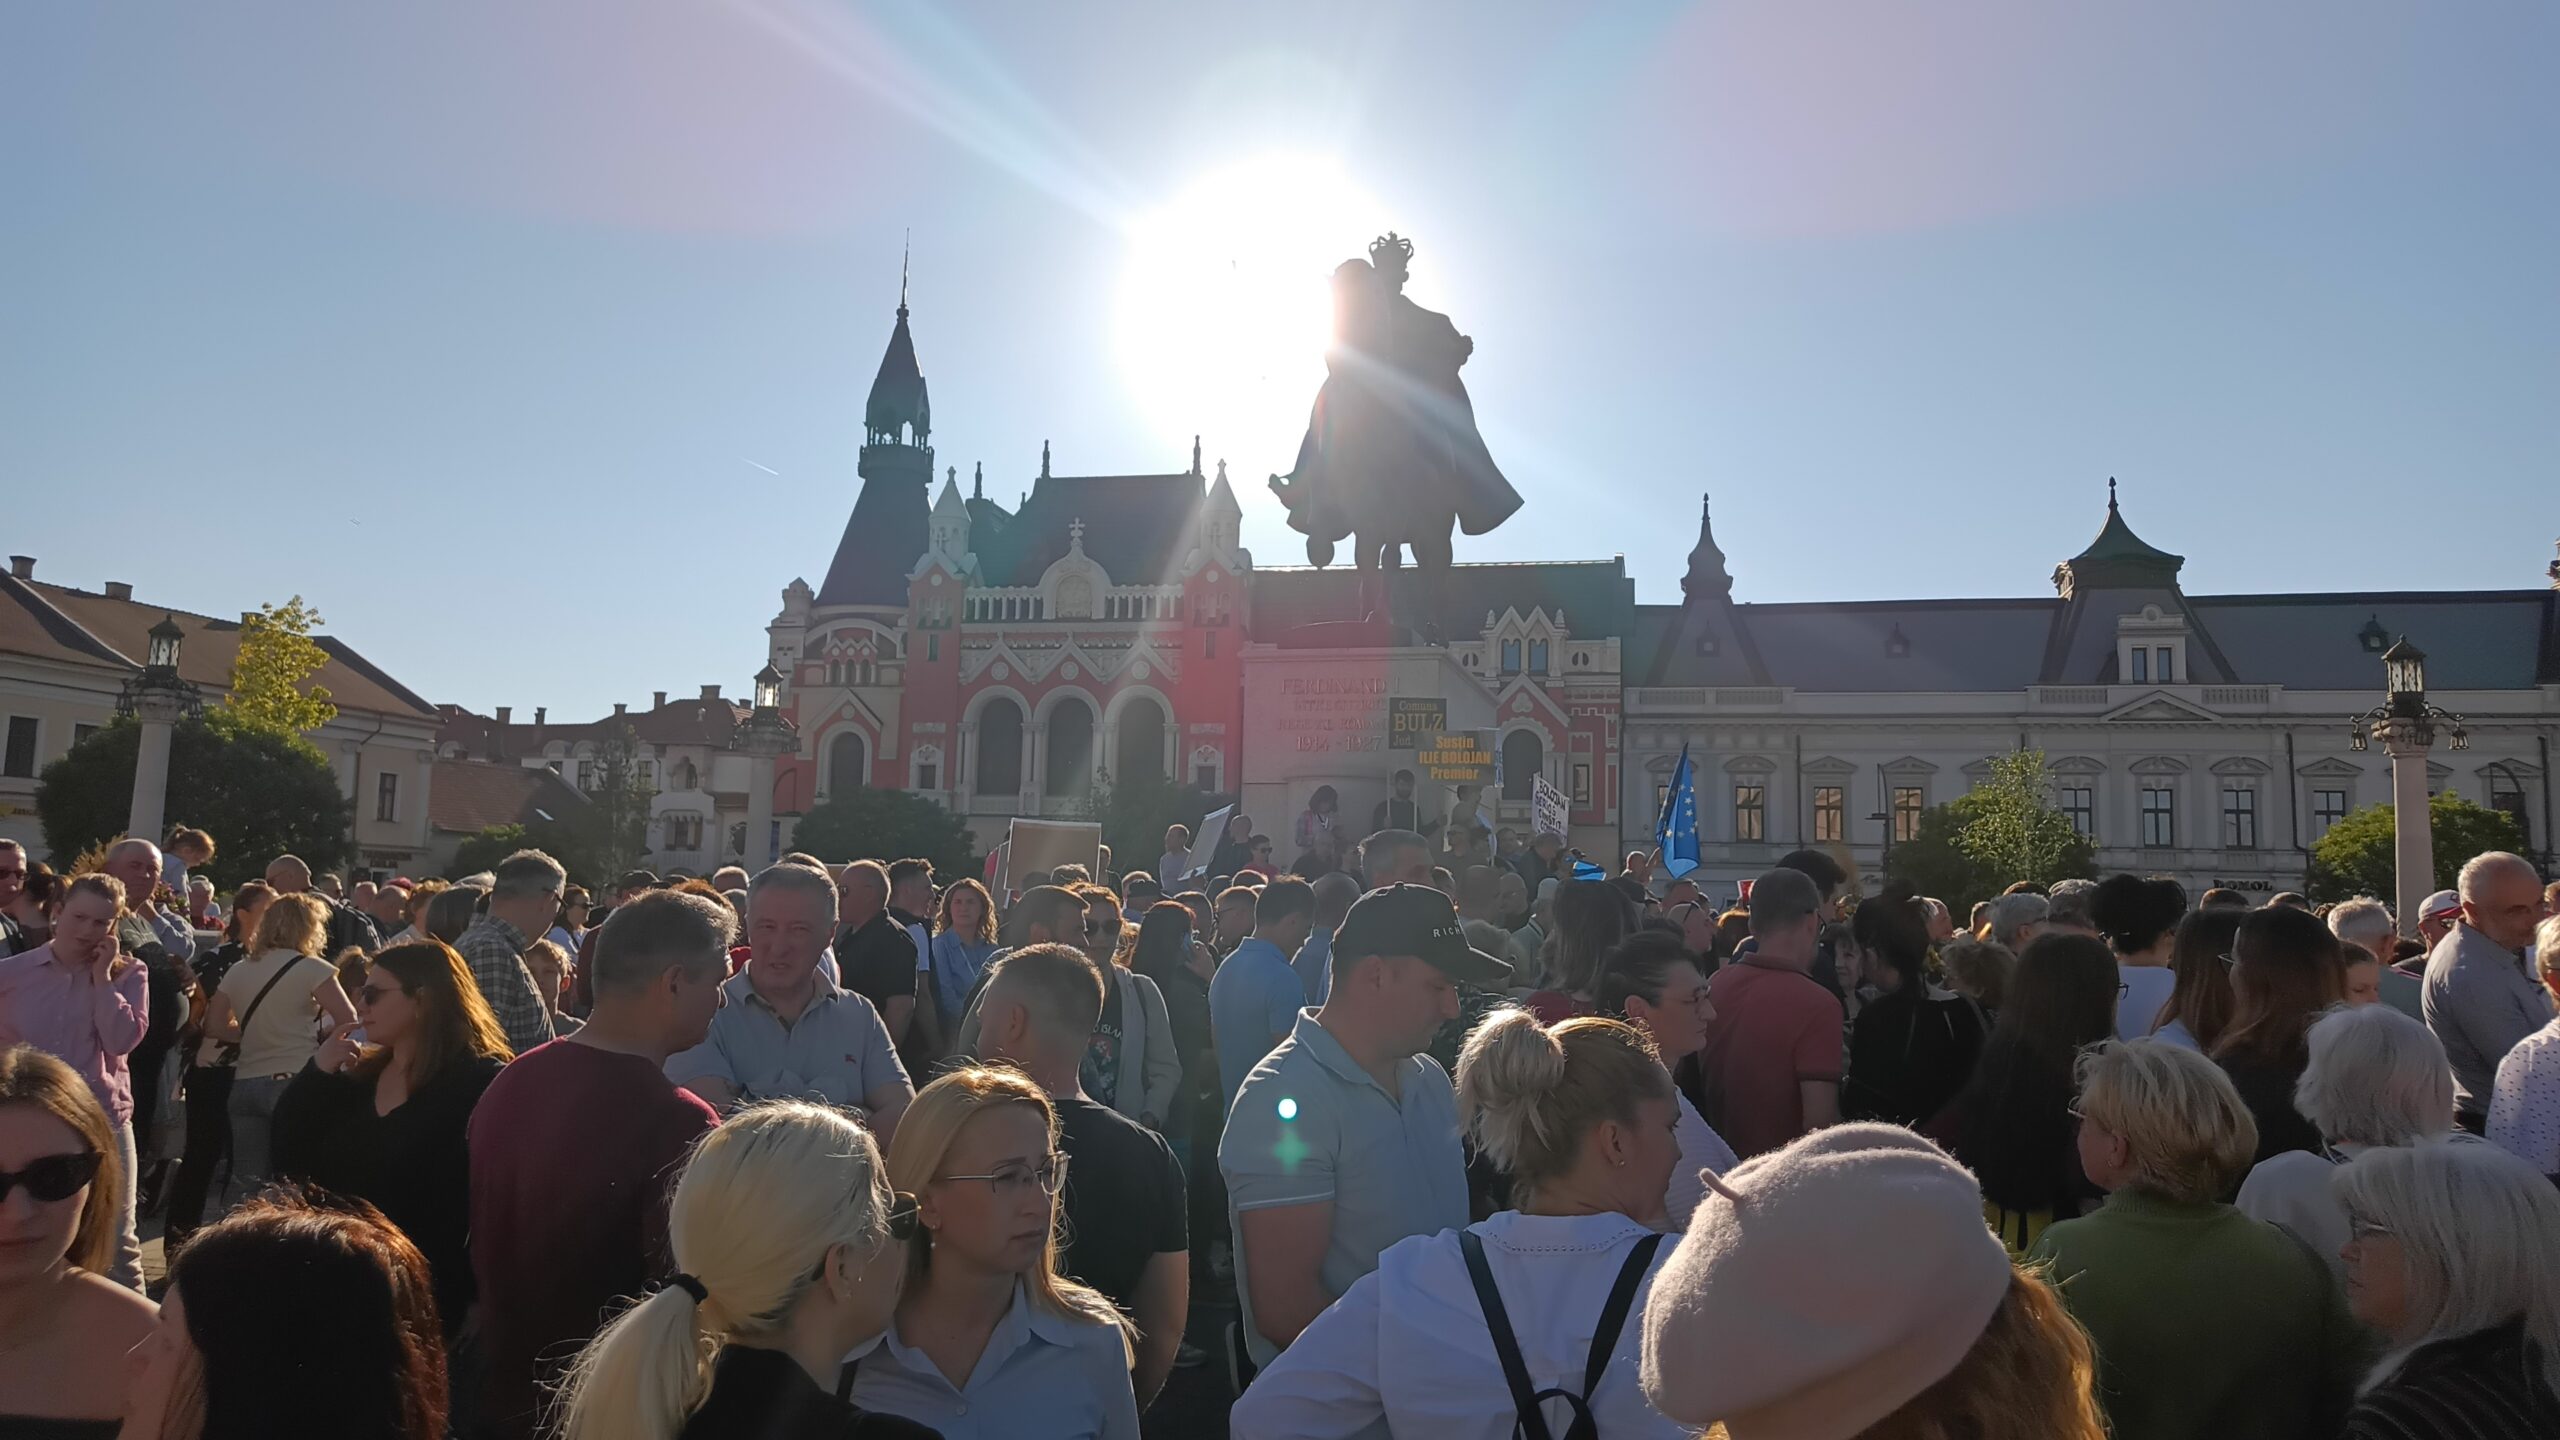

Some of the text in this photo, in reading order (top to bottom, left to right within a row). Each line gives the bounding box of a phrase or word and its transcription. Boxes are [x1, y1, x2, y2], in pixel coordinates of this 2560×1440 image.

[1280, 678, 1387, 695] FERDINAND
[1399, 700, 1438, 712] Comuna
[1393, 713, 1444, 732] BULZ
[1419, 751, 1491, 764] ILIE BOLOJAN
[1430, 766, 1479, 780] Premier
